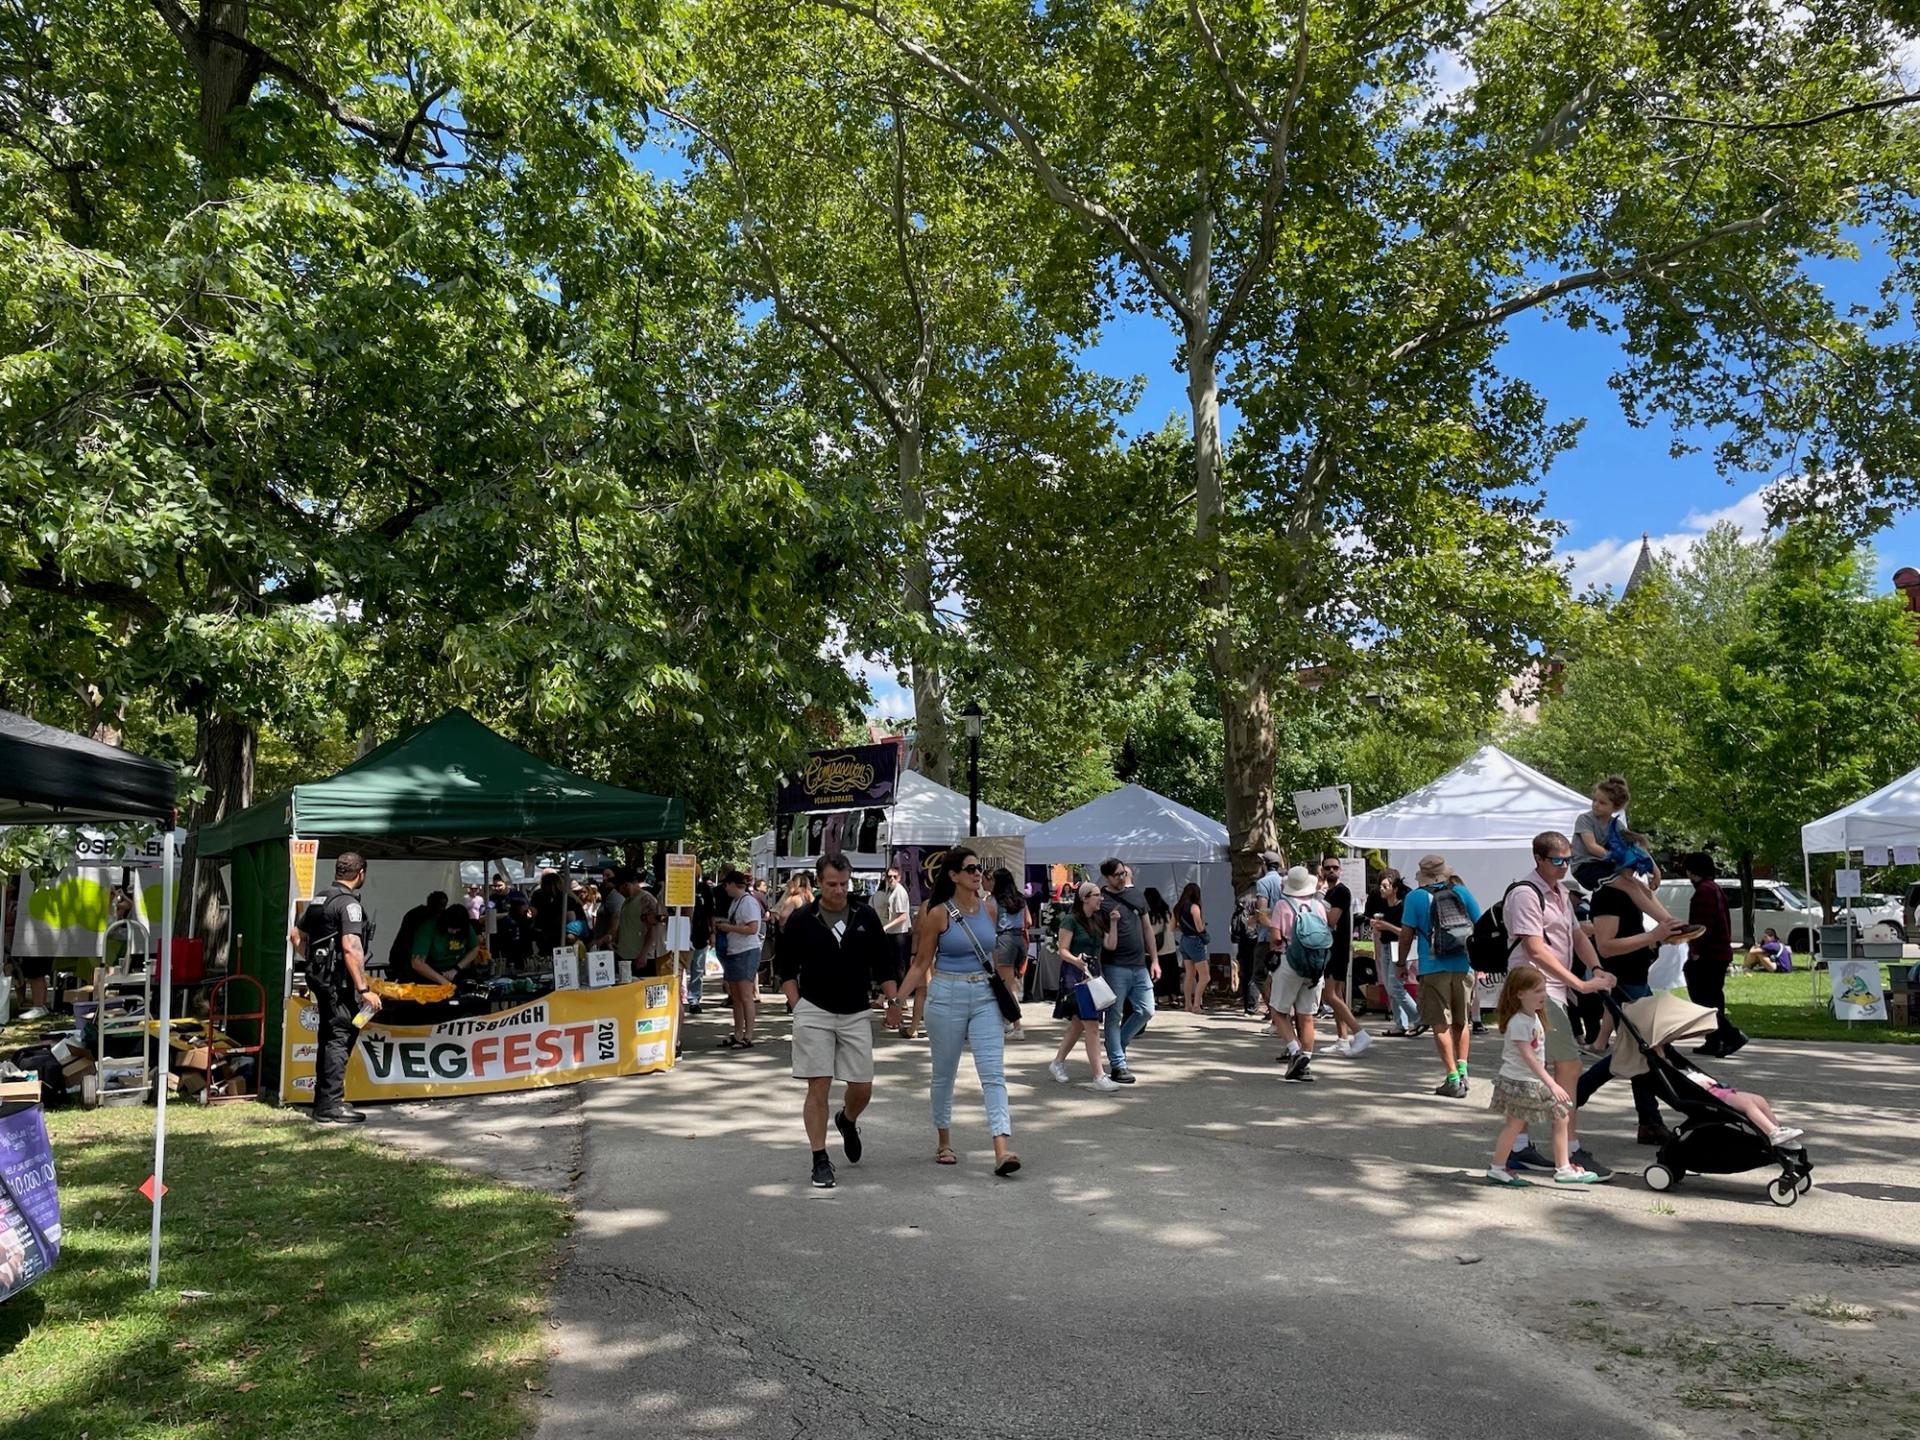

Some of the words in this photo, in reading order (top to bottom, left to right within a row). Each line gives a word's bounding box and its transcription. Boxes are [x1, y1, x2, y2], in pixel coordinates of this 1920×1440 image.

[803, 754, 874, 795] Compassion
[436, 1005, 545, 1036] PITTSBURGH
[362, 1025, 595, 1079] VEGFEST
[599, 1022, 614, 1061] 2024
